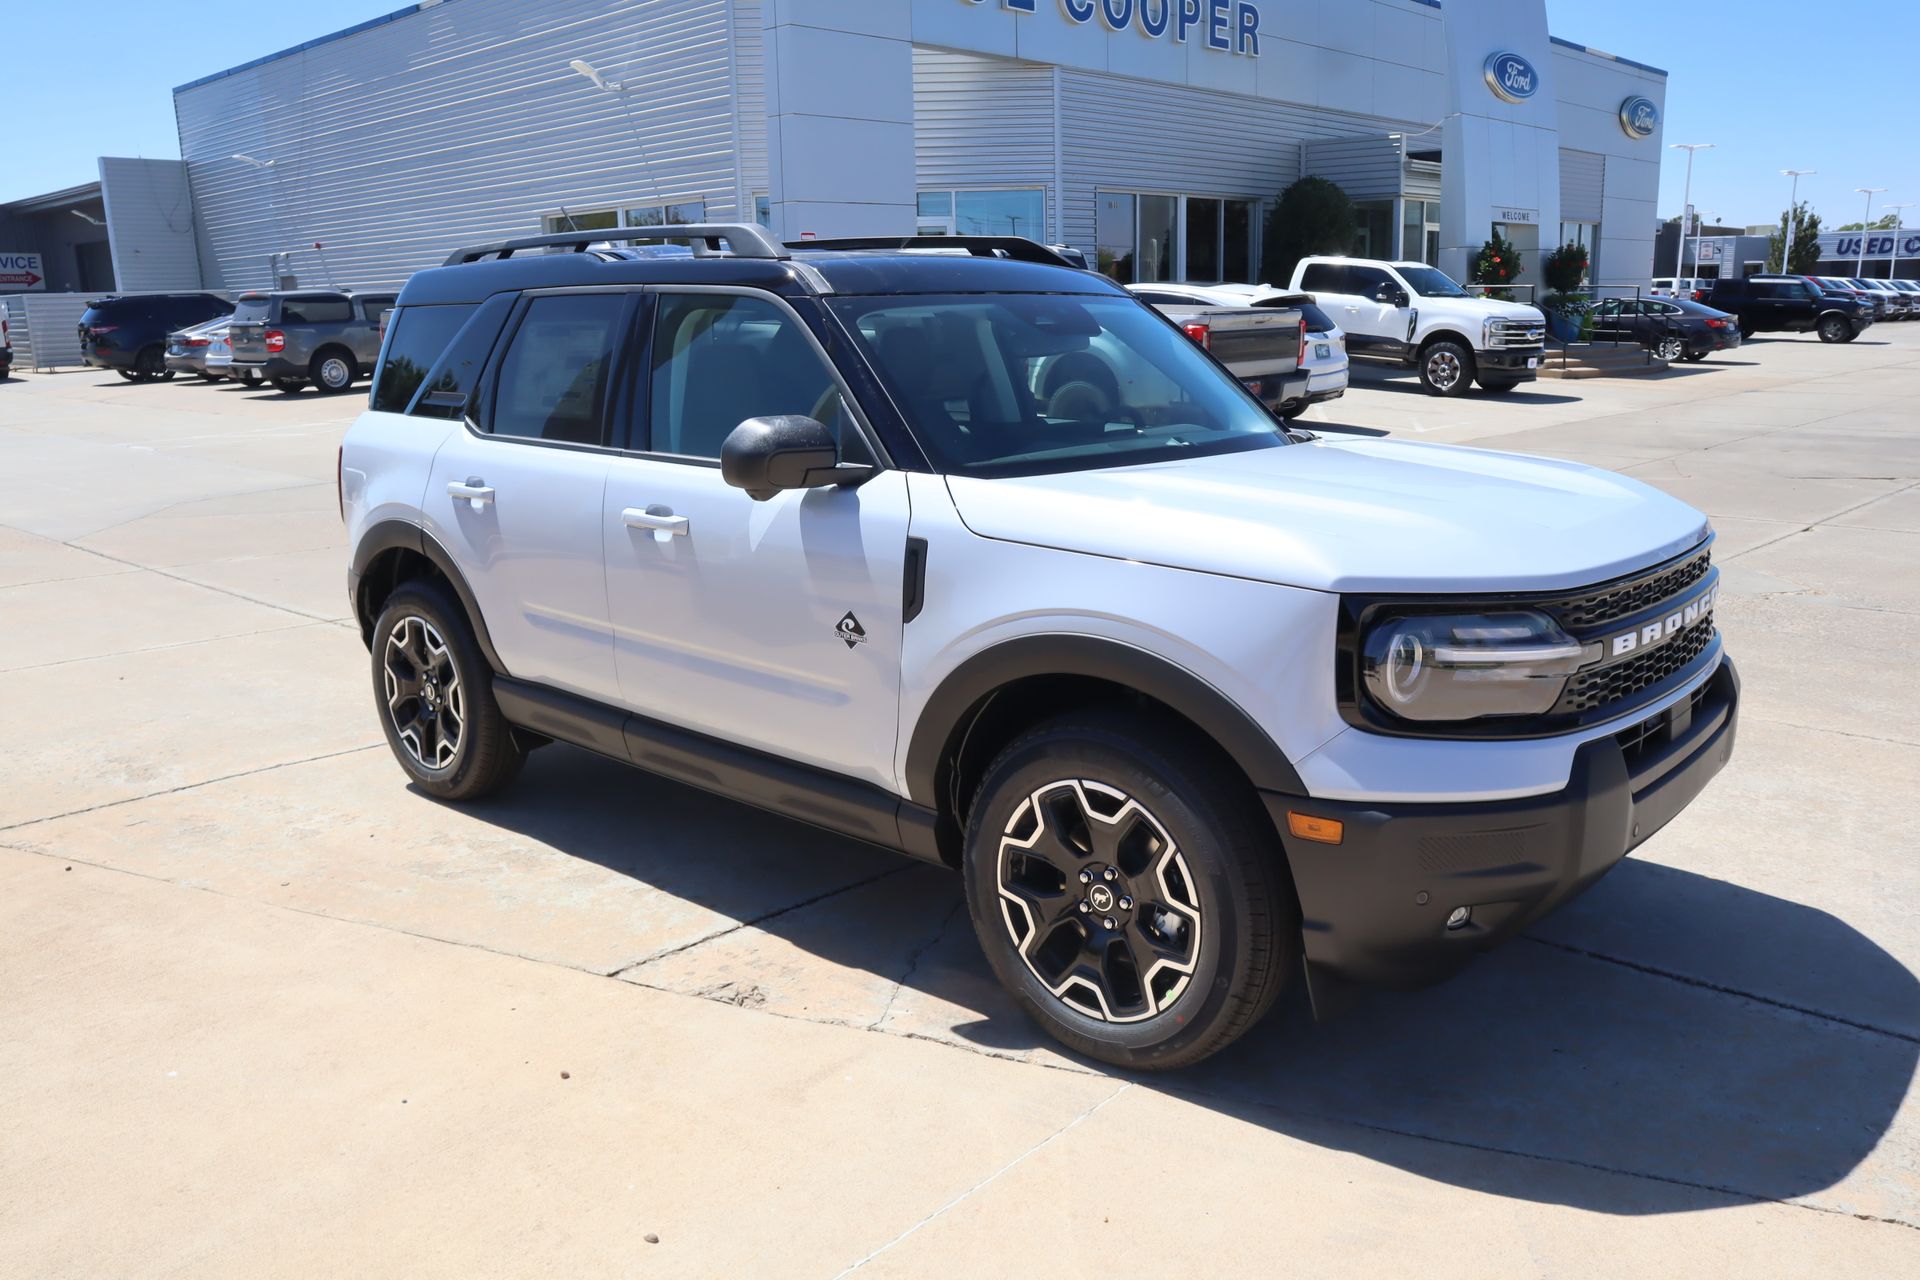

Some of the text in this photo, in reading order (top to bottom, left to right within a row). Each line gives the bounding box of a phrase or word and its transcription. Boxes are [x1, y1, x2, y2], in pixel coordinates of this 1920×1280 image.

[1505, 61, 1531, 91] Ford
[1635, 105, 1655, 128] Ford
[1502, 211, 1530, 221] WELCOME
[1837, 237, 1895, 255] USED
